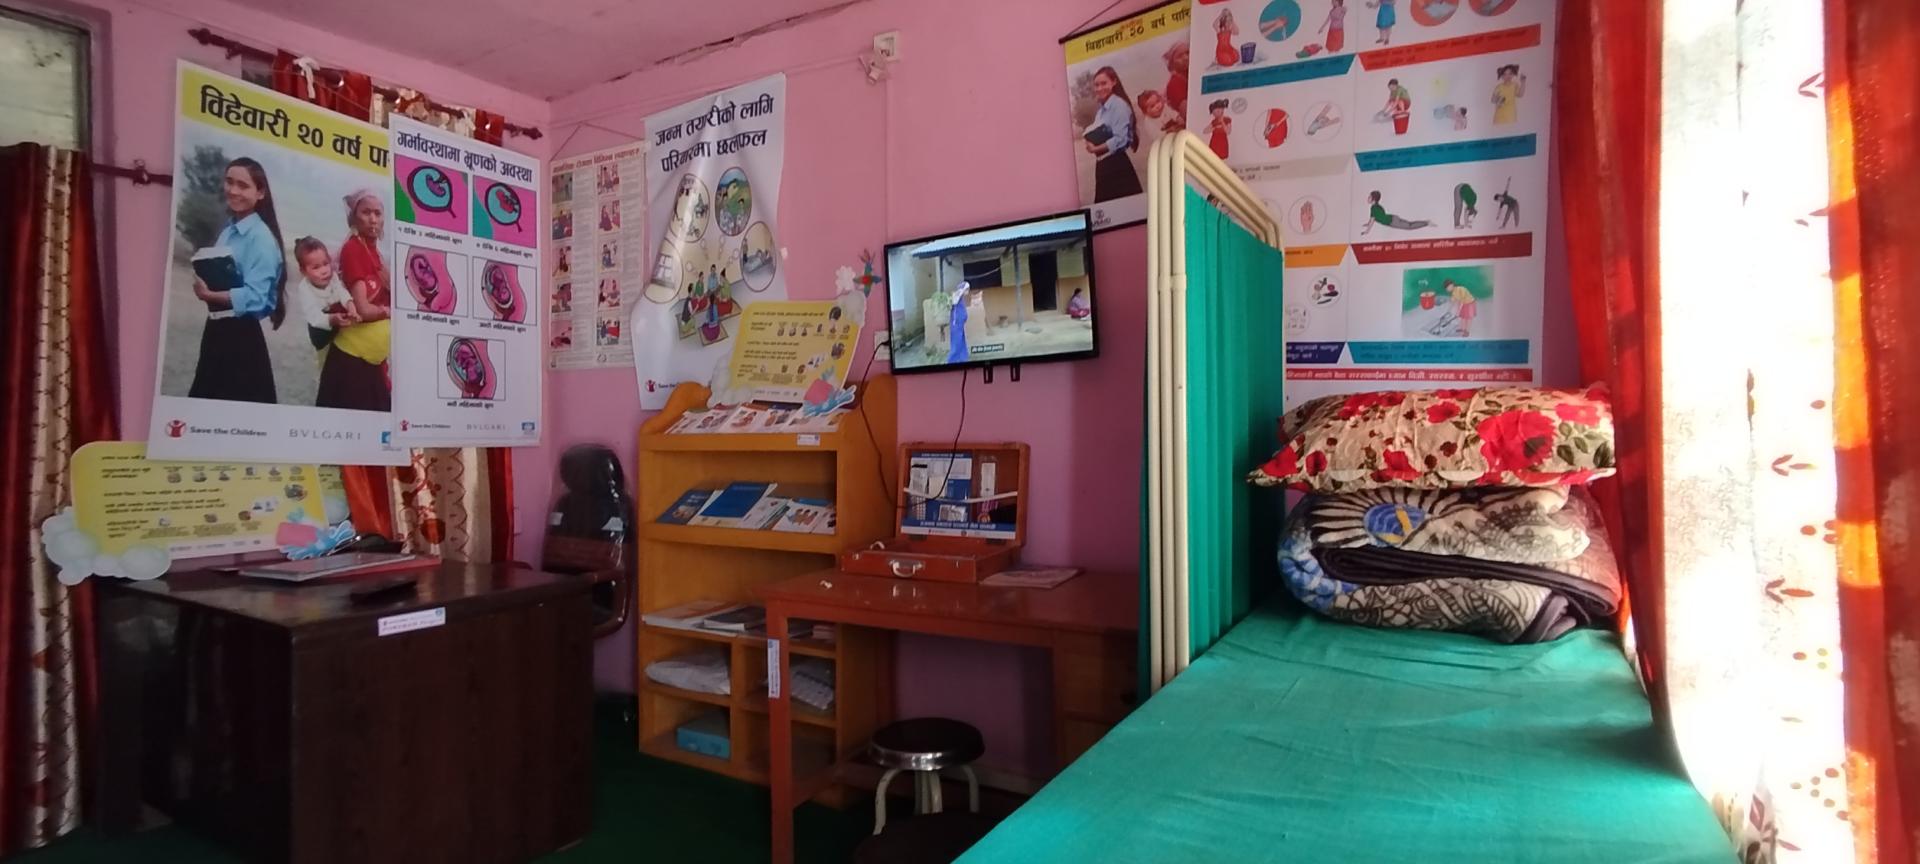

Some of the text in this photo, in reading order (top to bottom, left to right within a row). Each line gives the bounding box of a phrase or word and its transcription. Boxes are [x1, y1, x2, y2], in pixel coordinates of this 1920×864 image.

[1130, 26, 1145, 38] २०
[655, 92, 774, 147] जन्म तयारीको लागि
[297, 123, 324, 148] २०
[332, 133, 362, 160] वर्ष
[369, 144, 390, 168] पा
[397, 131, 461, 163] गर्भावस्थामा
[500, 160, 533, 183] अवस्था
[661, 141, 712, 172] परिवारमा
[716, 129, 768, 156] छलफल
[190, 425, 267, 437] Save the Children
[289, 428, 362, 440] BVLGARI
[466, 423, 506, 431] BVLGARI
